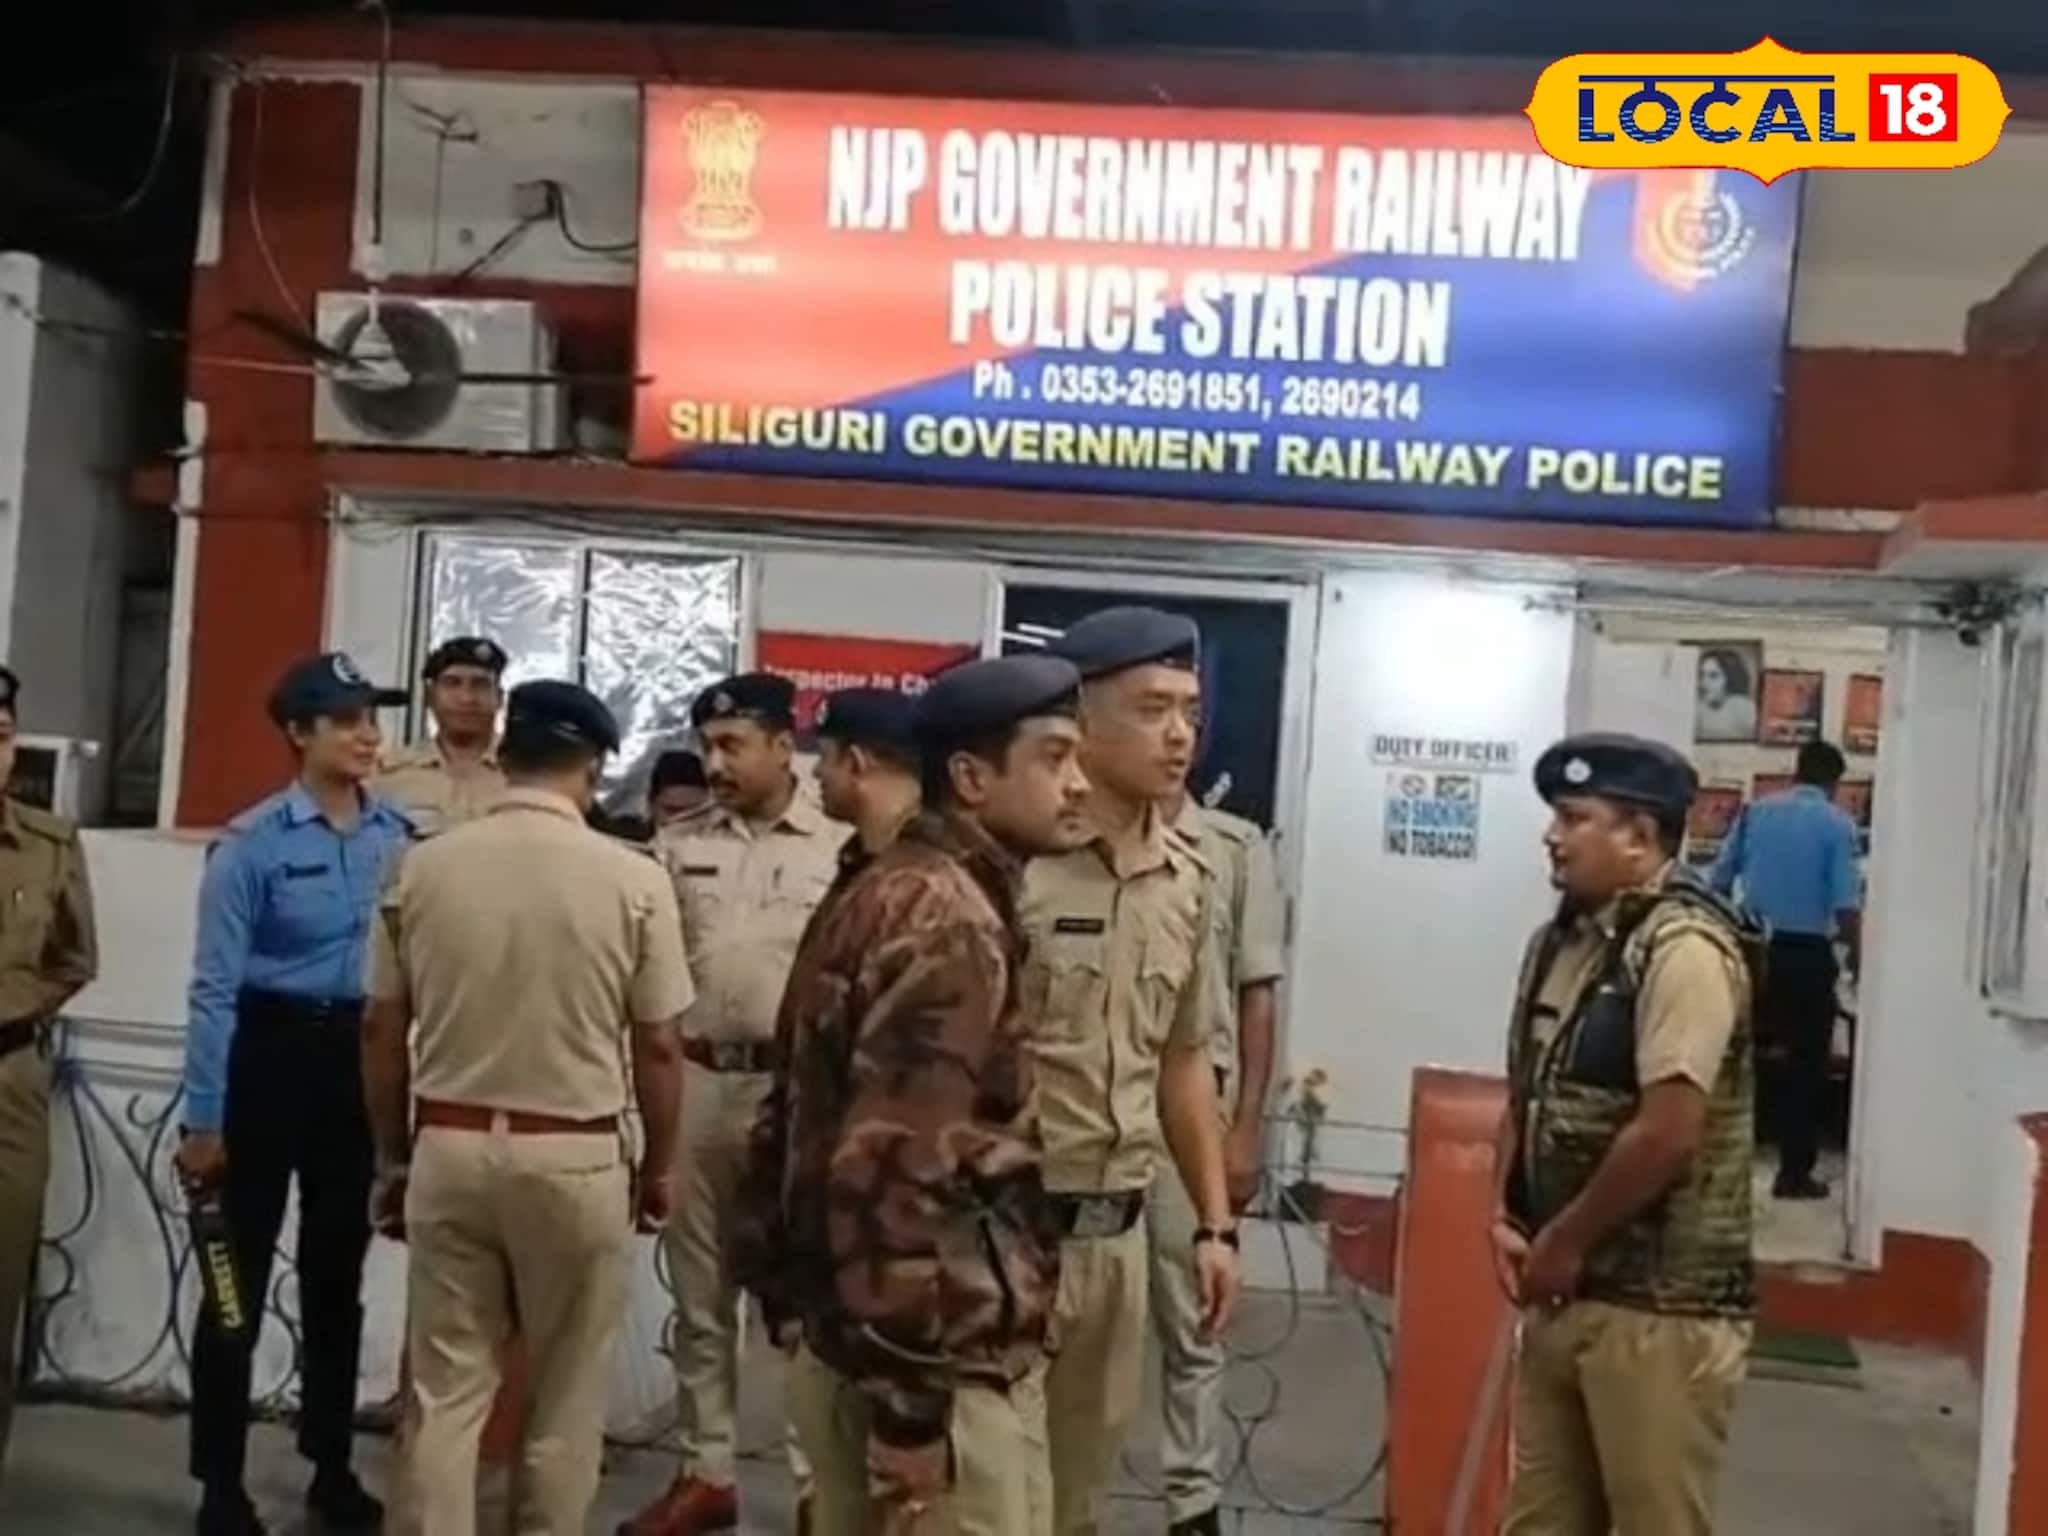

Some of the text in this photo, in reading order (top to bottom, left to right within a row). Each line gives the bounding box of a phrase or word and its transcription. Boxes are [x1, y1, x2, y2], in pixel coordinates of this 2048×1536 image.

[829, 125, 927, 232] NJP
[938, 128, 1325, 249] GOVERNMENT
[1332, 144, 1593, 261] RAILWAY
[949, 261, 1451, 368] POLICE STATION
[1041, 363, 1272, 419] 0353-2691851,
[1281, 376, 1420, 420] 2690214
[669, 400, 1723, 499] SILIGURI GOVERNMENT RAILWAY POLICE
[1375, 735, 1510, 761] DUTY OFFICER
[1389, 829, 1407, 855] NO
